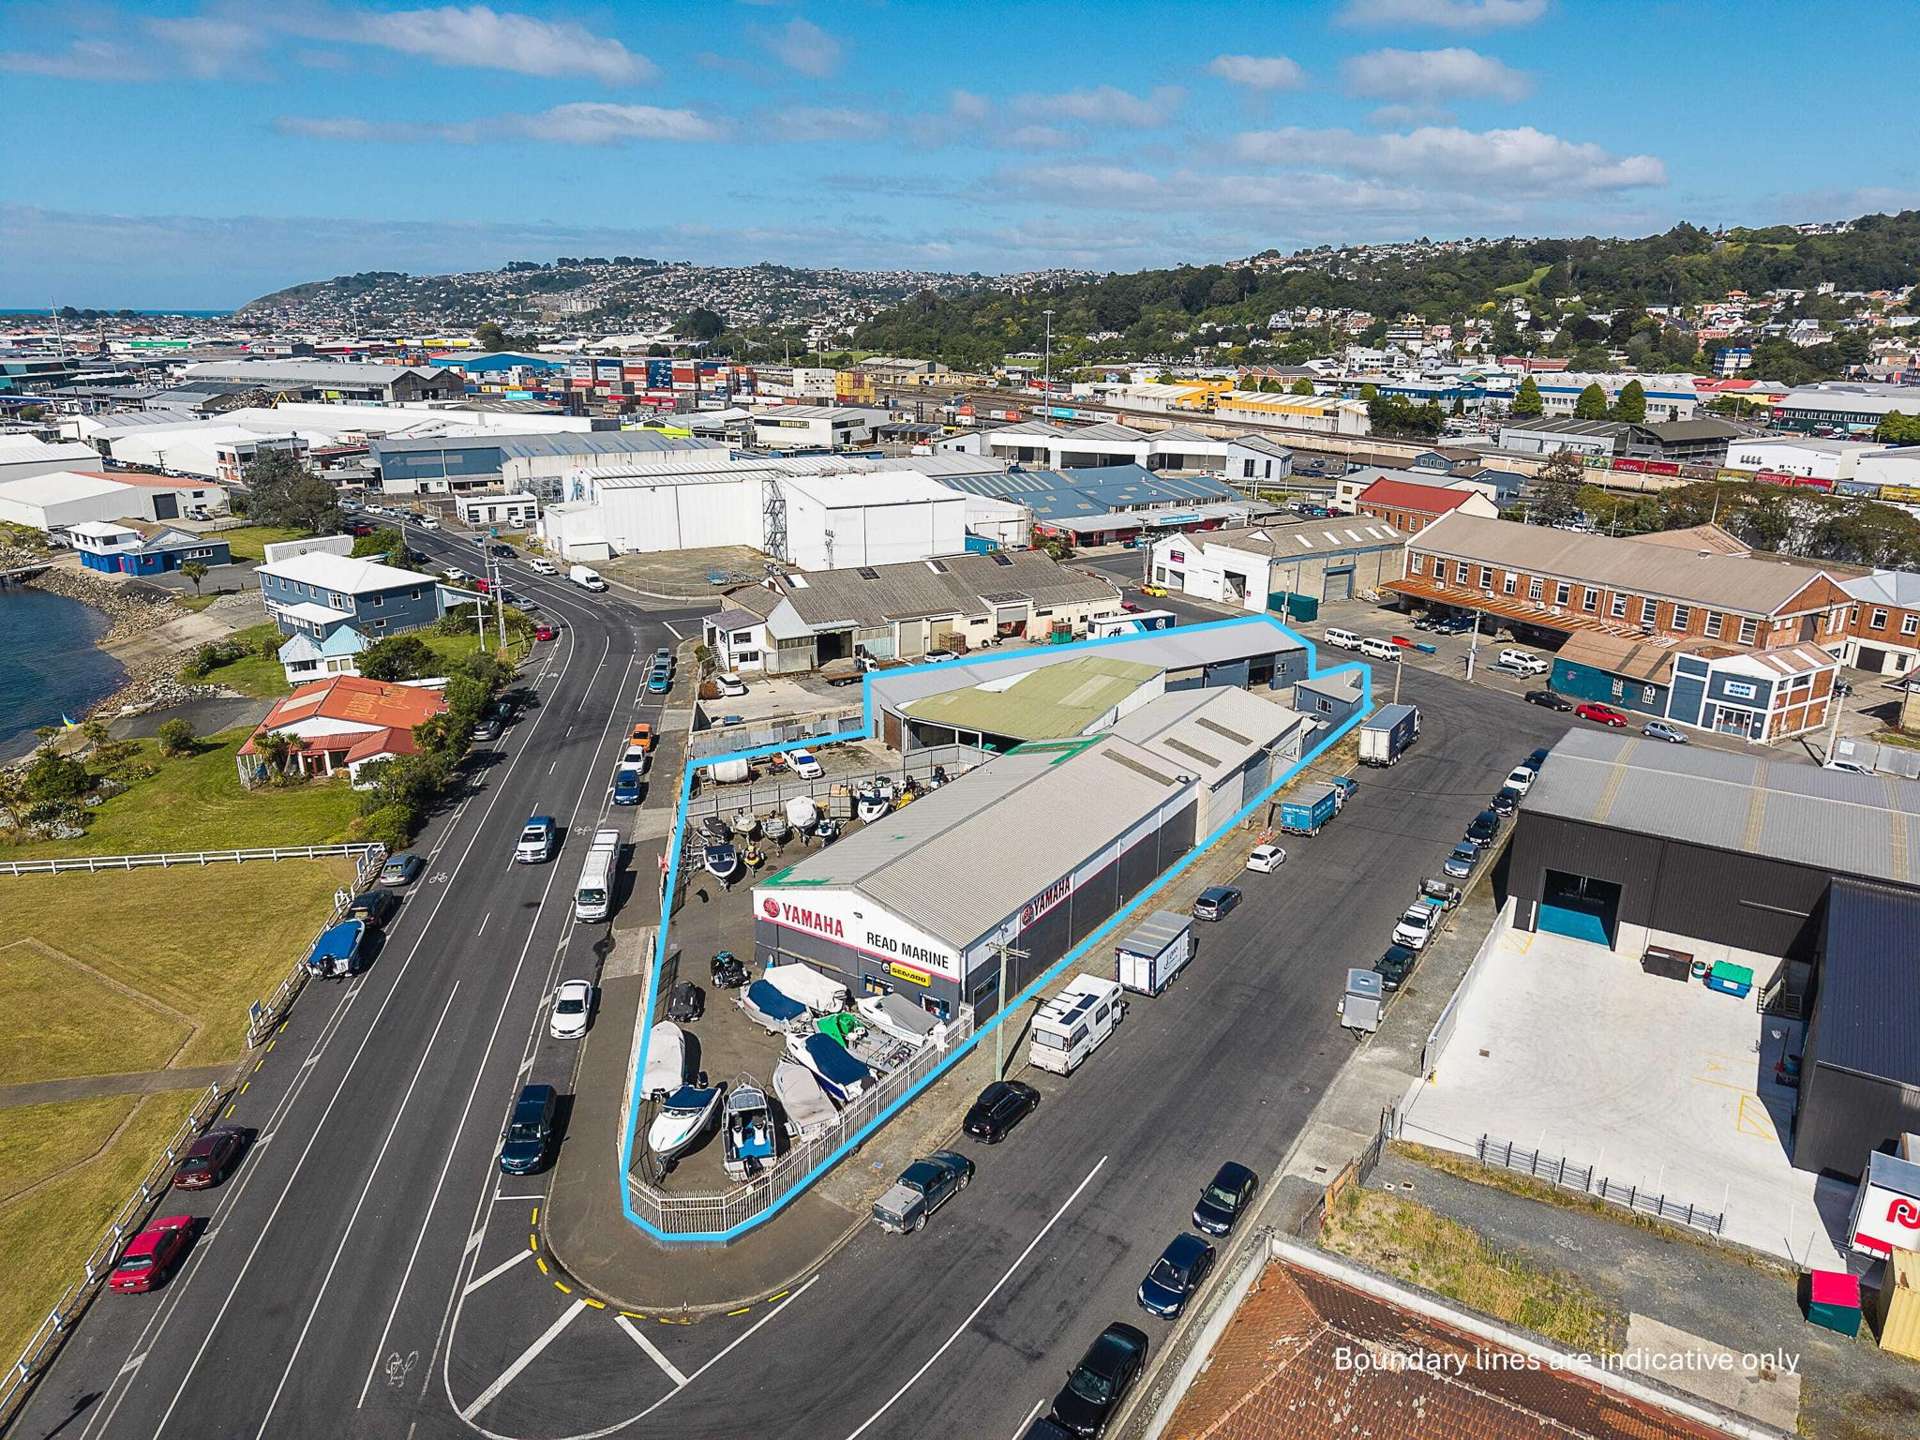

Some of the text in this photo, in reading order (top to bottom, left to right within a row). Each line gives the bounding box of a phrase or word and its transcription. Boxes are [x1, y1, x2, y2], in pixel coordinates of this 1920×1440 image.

[1033, 876, 1071, 916] YAMAHA
[782, 902, 844, 938] YAMAHA
[866, 931, 949, 970] READ MARINE
